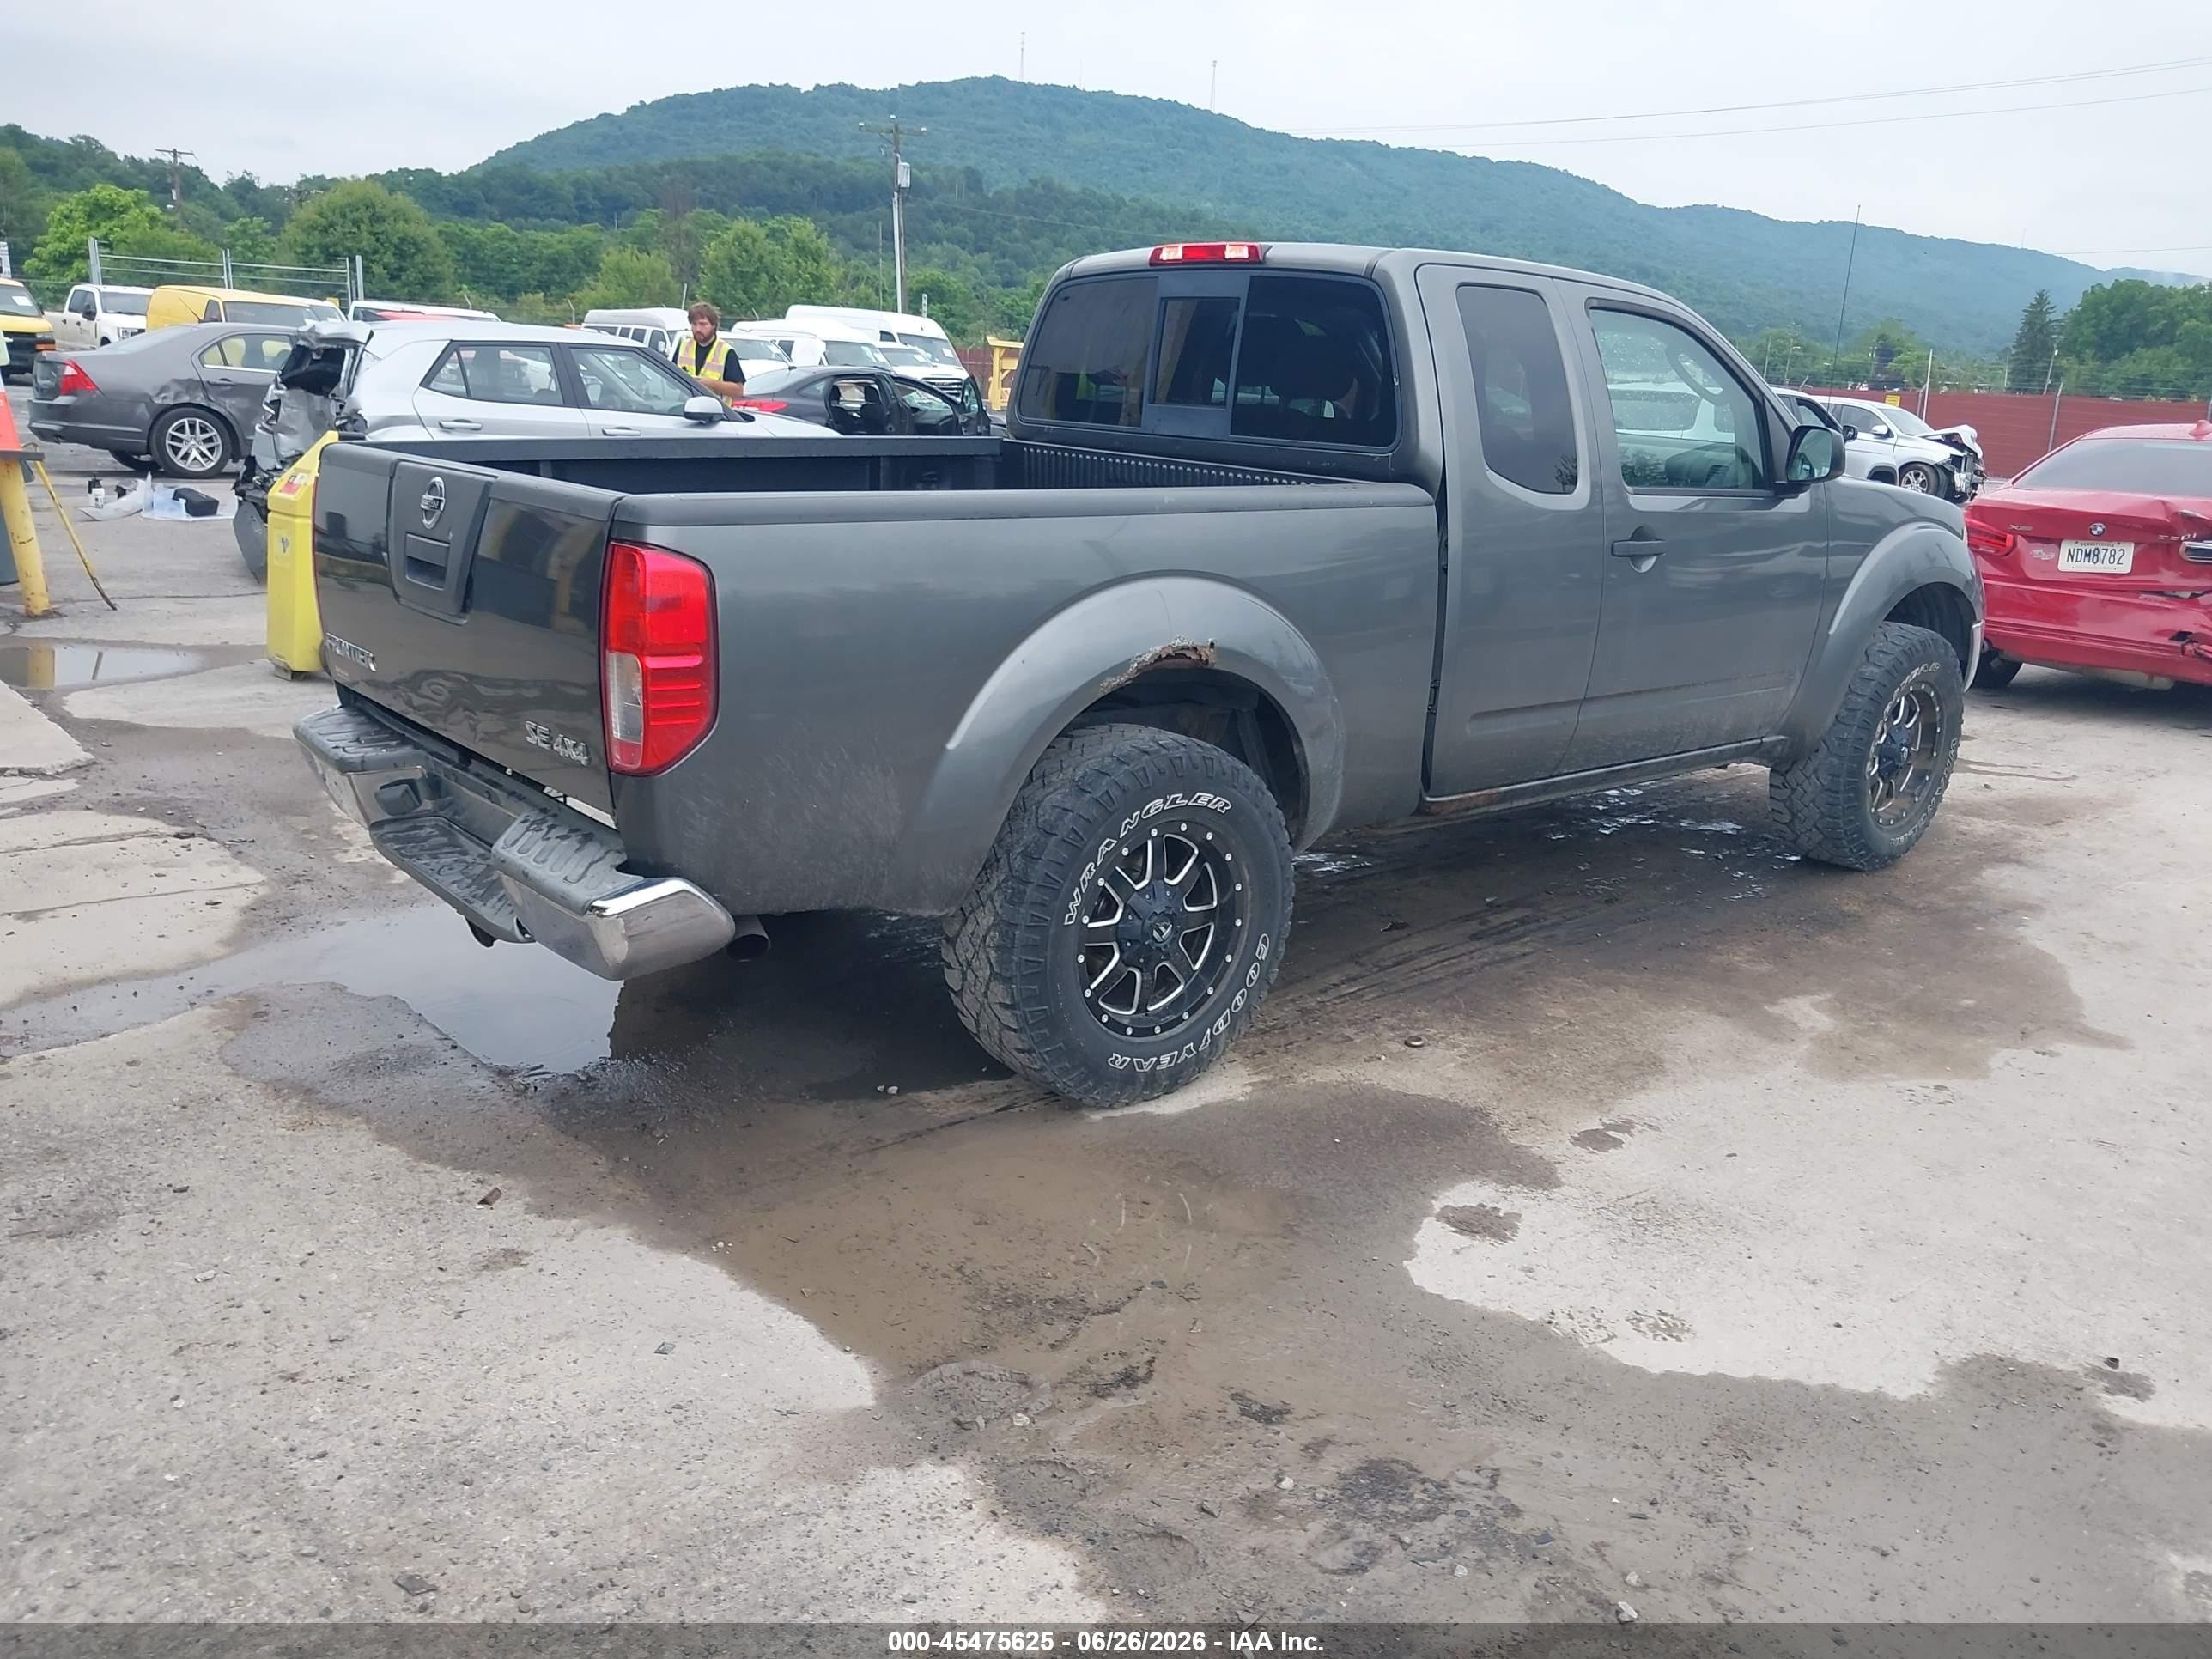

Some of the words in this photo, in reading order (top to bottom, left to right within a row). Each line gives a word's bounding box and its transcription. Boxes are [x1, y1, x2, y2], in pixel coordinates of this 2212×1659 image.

[2066, 547, 2125, 565] NDM8782
[326, 632, 377, 672] FRONTIER
[525, 720, 551, 750] SE
[1064, 792, 1232, 926] WRANGLER
[1107, 933, 1271, 1073] GOODYEAR
